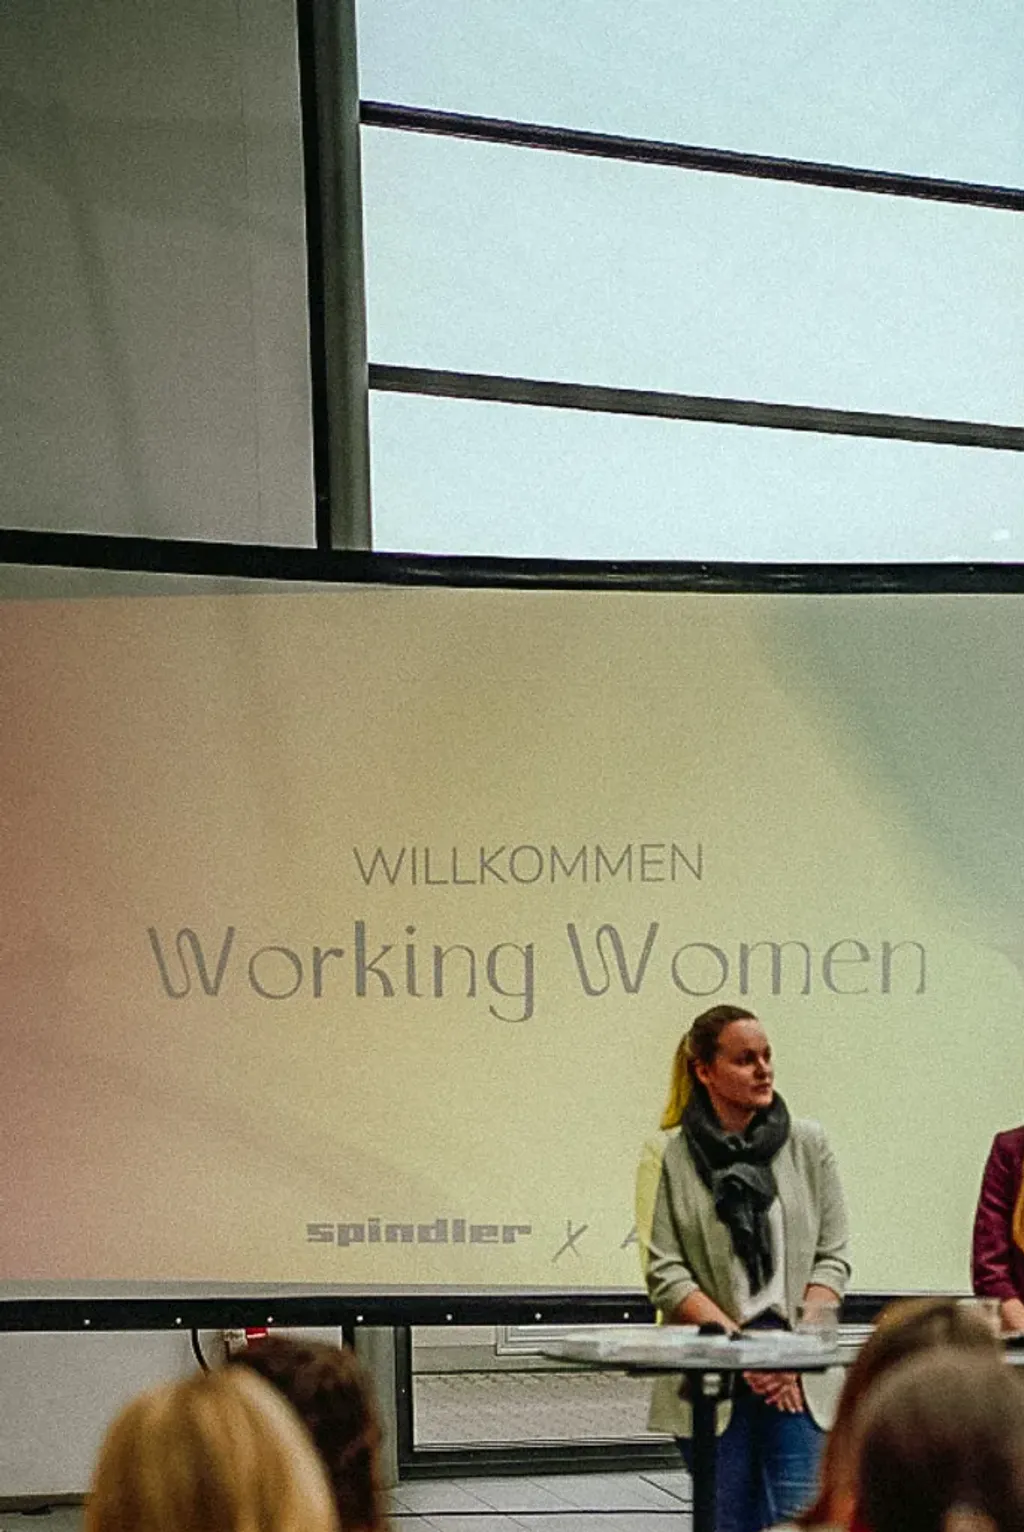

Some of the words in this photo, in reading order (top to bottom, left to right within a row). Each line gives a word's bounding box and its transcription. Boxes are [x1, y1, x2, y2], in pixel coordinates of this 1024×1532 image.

[352, 843, 703, 885] WILLKOMMEN
[146, 919, 535, 1024] Working
[566, 921, 927, 997] Women
[305, 1216, 533, 1248] spindler
